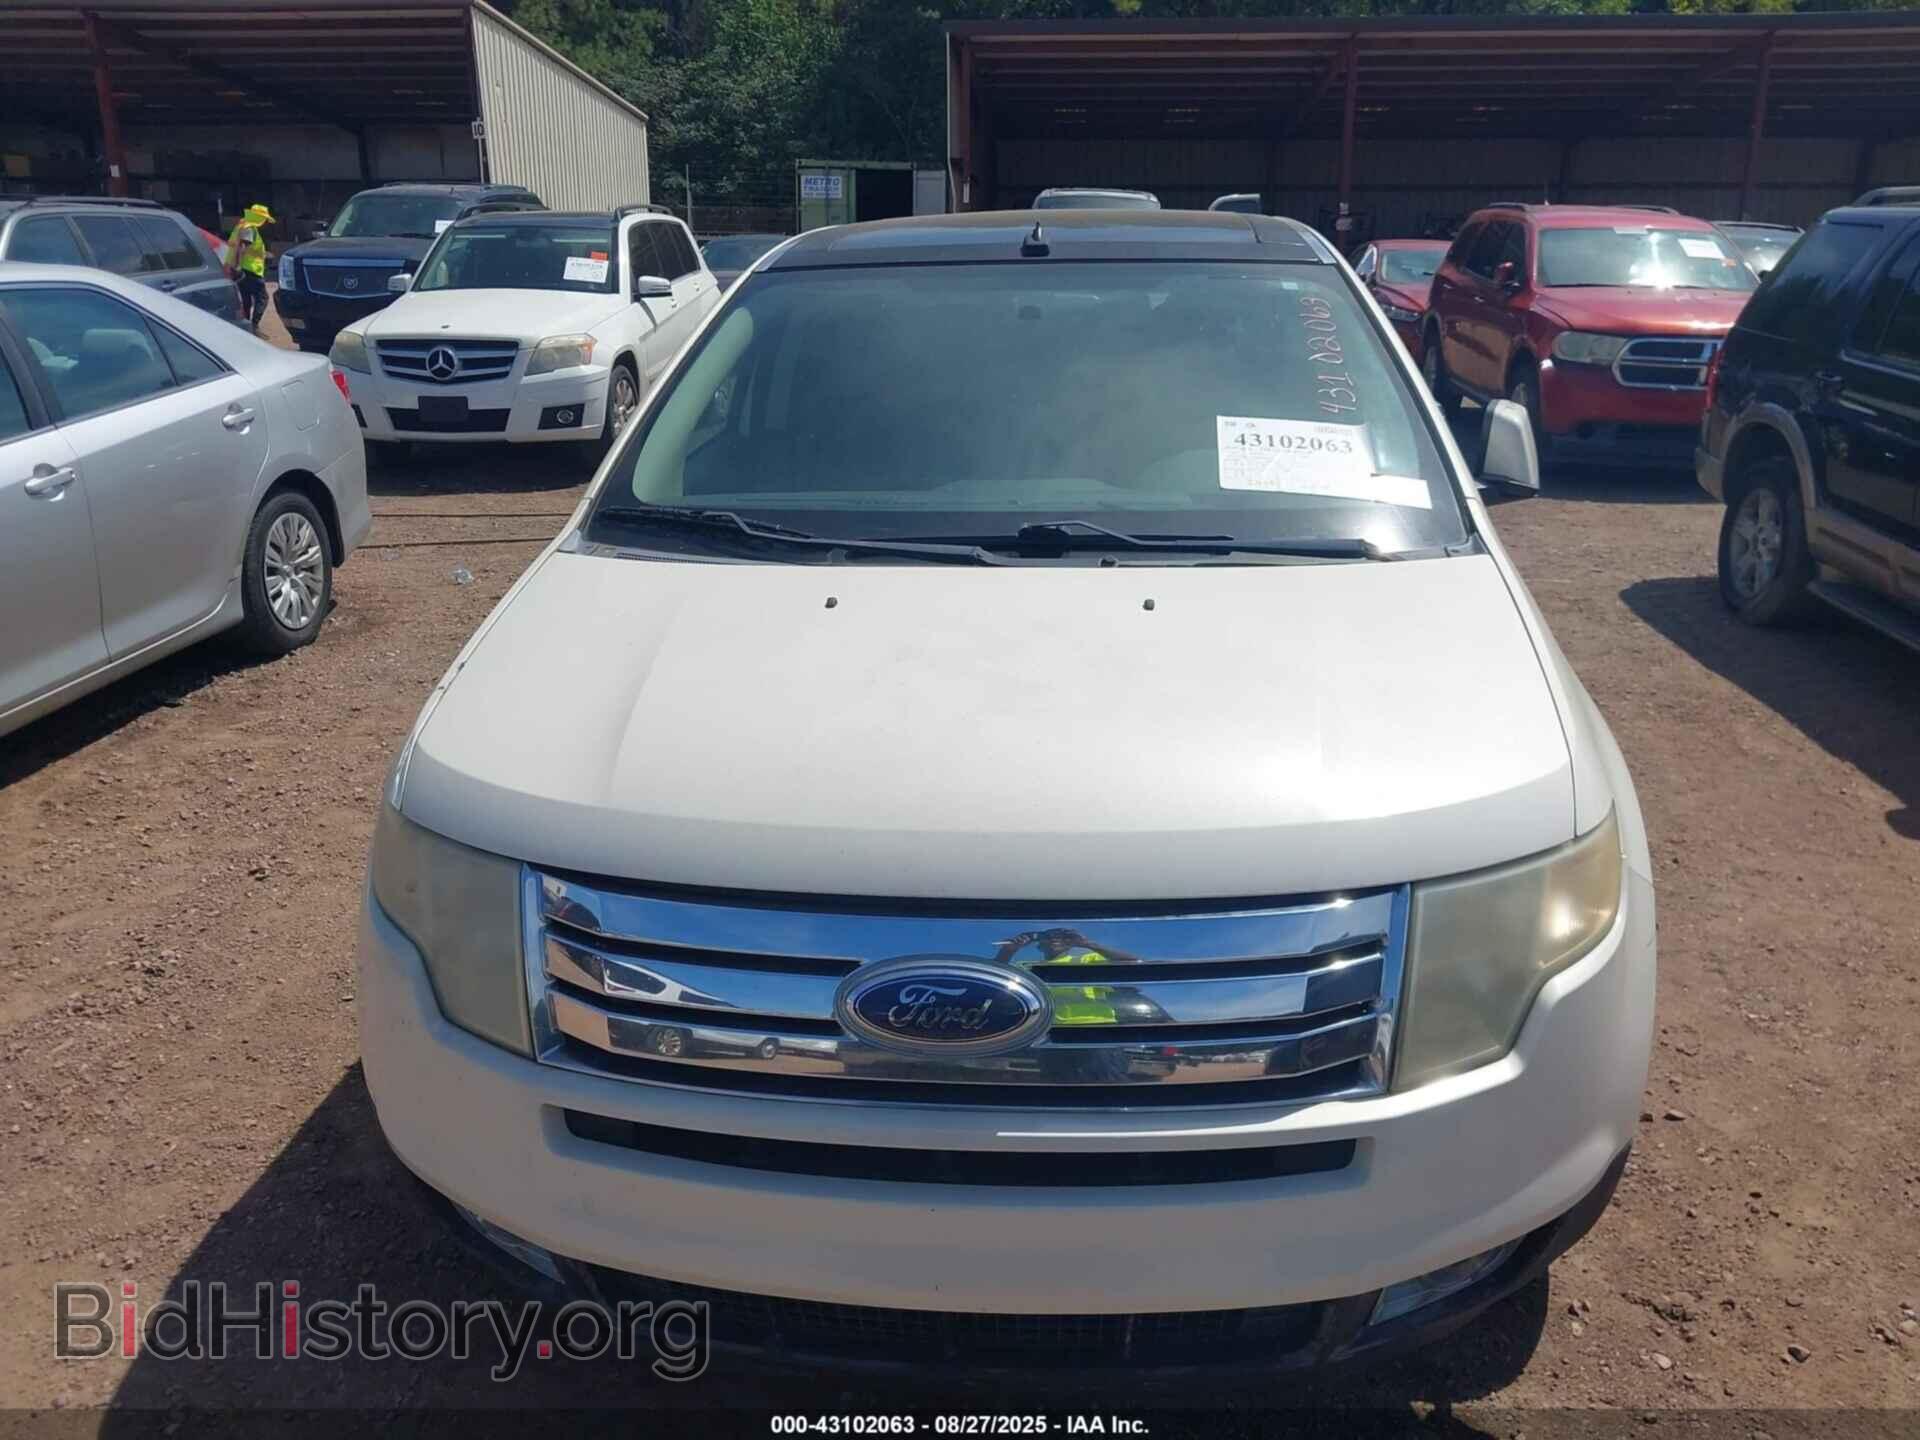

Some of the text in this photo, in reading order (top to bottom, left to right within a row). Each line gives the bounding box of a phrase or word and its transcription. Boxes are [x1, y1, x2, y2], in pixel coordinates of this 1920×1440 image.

[804, 176, 840, 186] METRO
[1234, 432, 1353, 454] 43102063
[888, 984, 993, 1030] Ford
